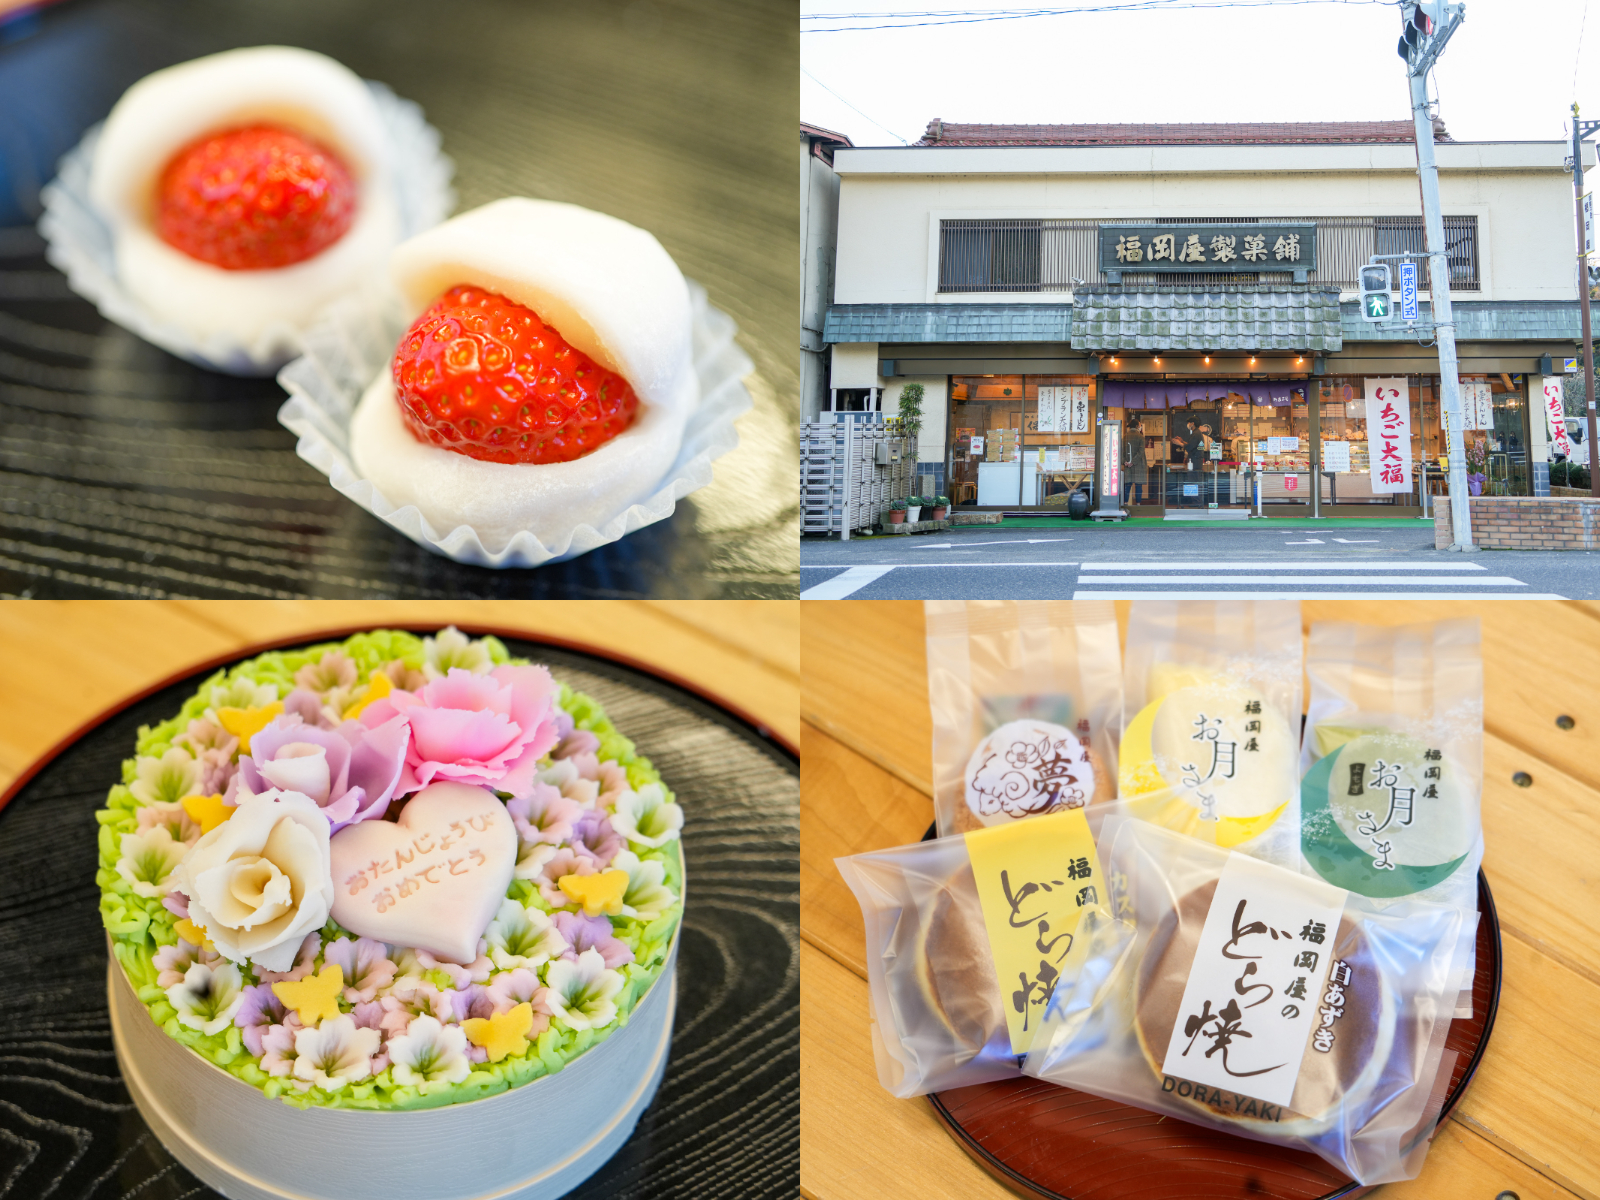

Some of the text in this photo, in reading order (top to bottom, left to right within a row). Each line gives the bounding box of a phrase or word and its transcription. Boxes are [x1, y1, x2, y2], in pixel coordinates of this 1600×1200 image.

[1115, 233, 1301, 263] 福岡屋製菓舗
[1403, 267, 1415, 317] 押ボタン式
[1375, 387, 1405, 485] いちご大福
[1244, 700, 1262, 752] 福岡屋
[1017, 751, 1079, 814] 夢
[1181, 714, 1237, 820] お月さま
[1422, 749, 1442, 799] 福岡屋
[1357, 761, 1416, 869] お月さま
[345, 811, 495, 895] おたんじょうび
[372, 849, 486, 913] おめでとう
[1182, 899, 1292, 1077] どら焼
[1281, 919, 1326, 1019] 福岡屋の
[1313, 960, 1352, 1053] 白あずき
[1161, 1076, 1282, 1122] DORA-YAKI
